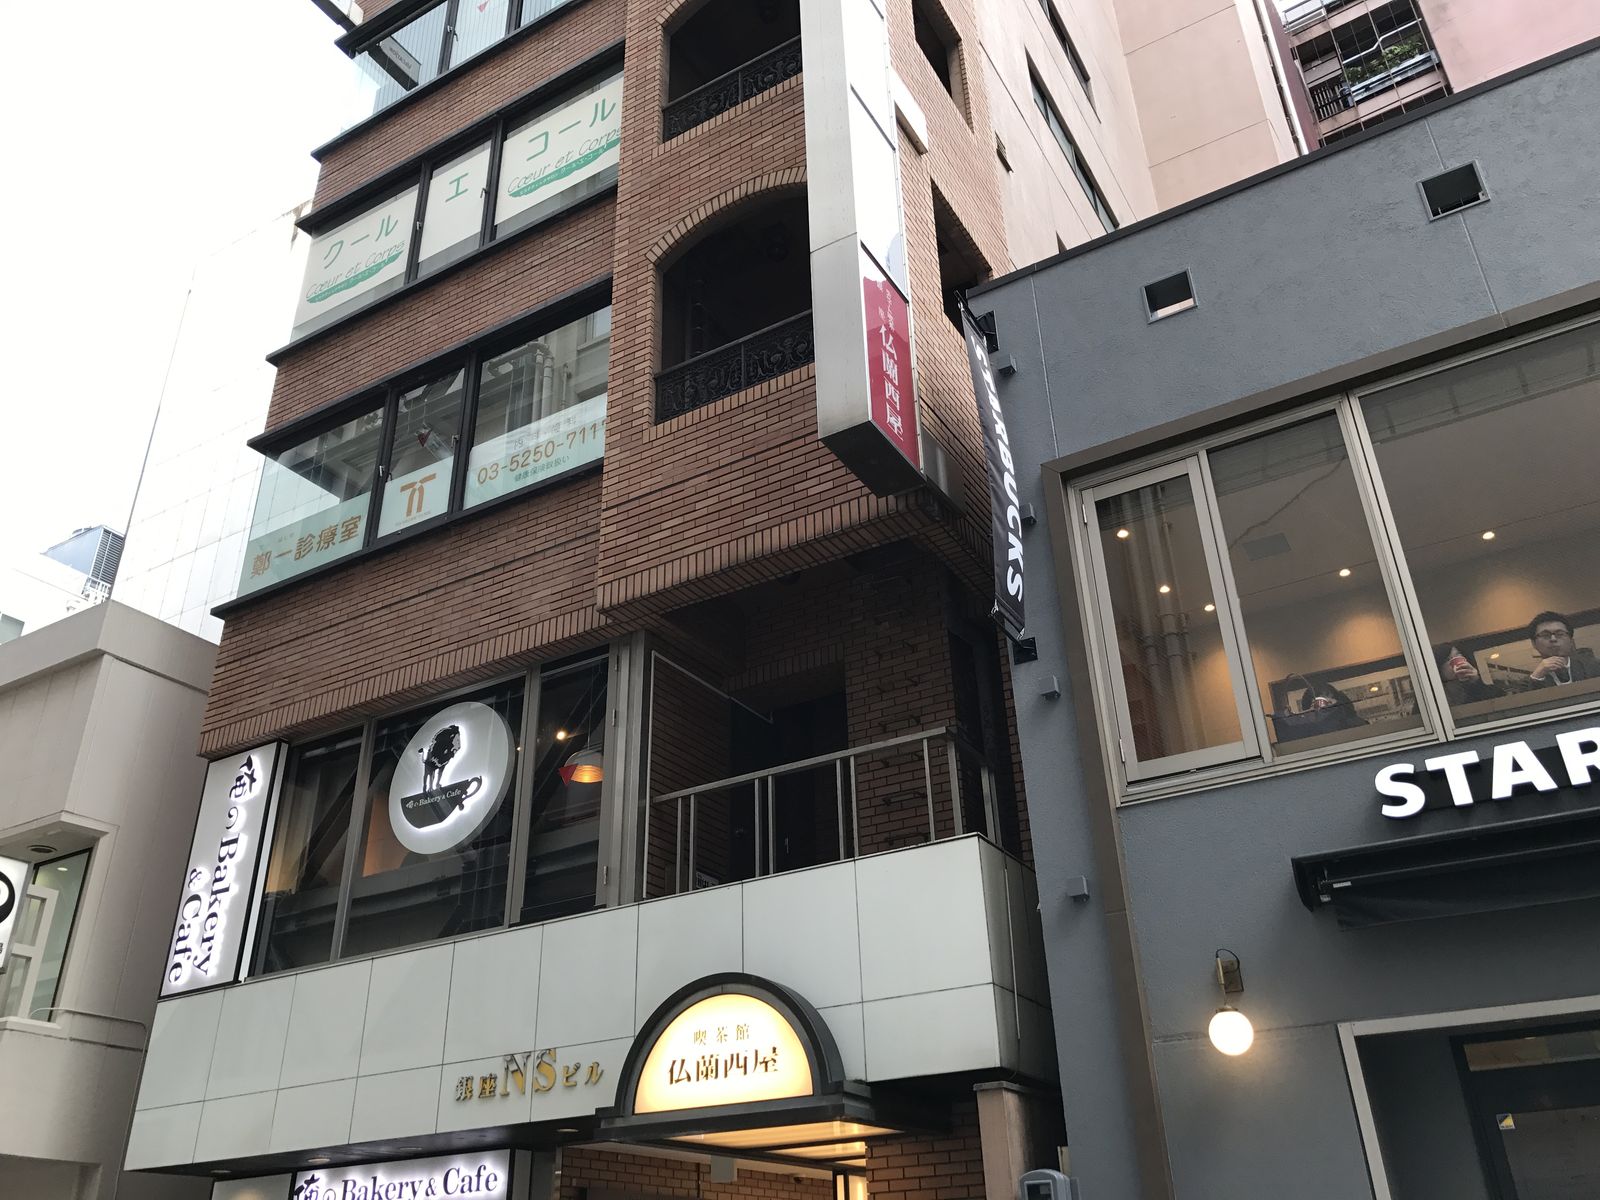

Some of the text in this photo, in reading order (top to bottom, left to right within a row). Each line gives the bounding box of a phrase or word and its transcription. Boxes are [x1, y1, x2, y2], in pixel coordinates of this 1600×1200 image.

[323, 98, 617, 270] クール エ コール
[554, 150, 575, 169] et
[969, 334, 1024, 603] STARBUCKS
[419, 796, 441, 807] Bakery
[446, 788, 462, 799] Cafe
[1374, 726, 1600, 818] STAR
[168, 867, 203, 984] & Cafe
[192, 832, 241, 976] Bakery
[668, 1046, 778, 1085] 仏蘭西屋
[693, 1023, 750, 1046] 喫茶館
[341, 1175, 423, 1200] Bakery
[425, 1177, 437, 1197] &
[442, 1164, 499, 1195] Cafe
